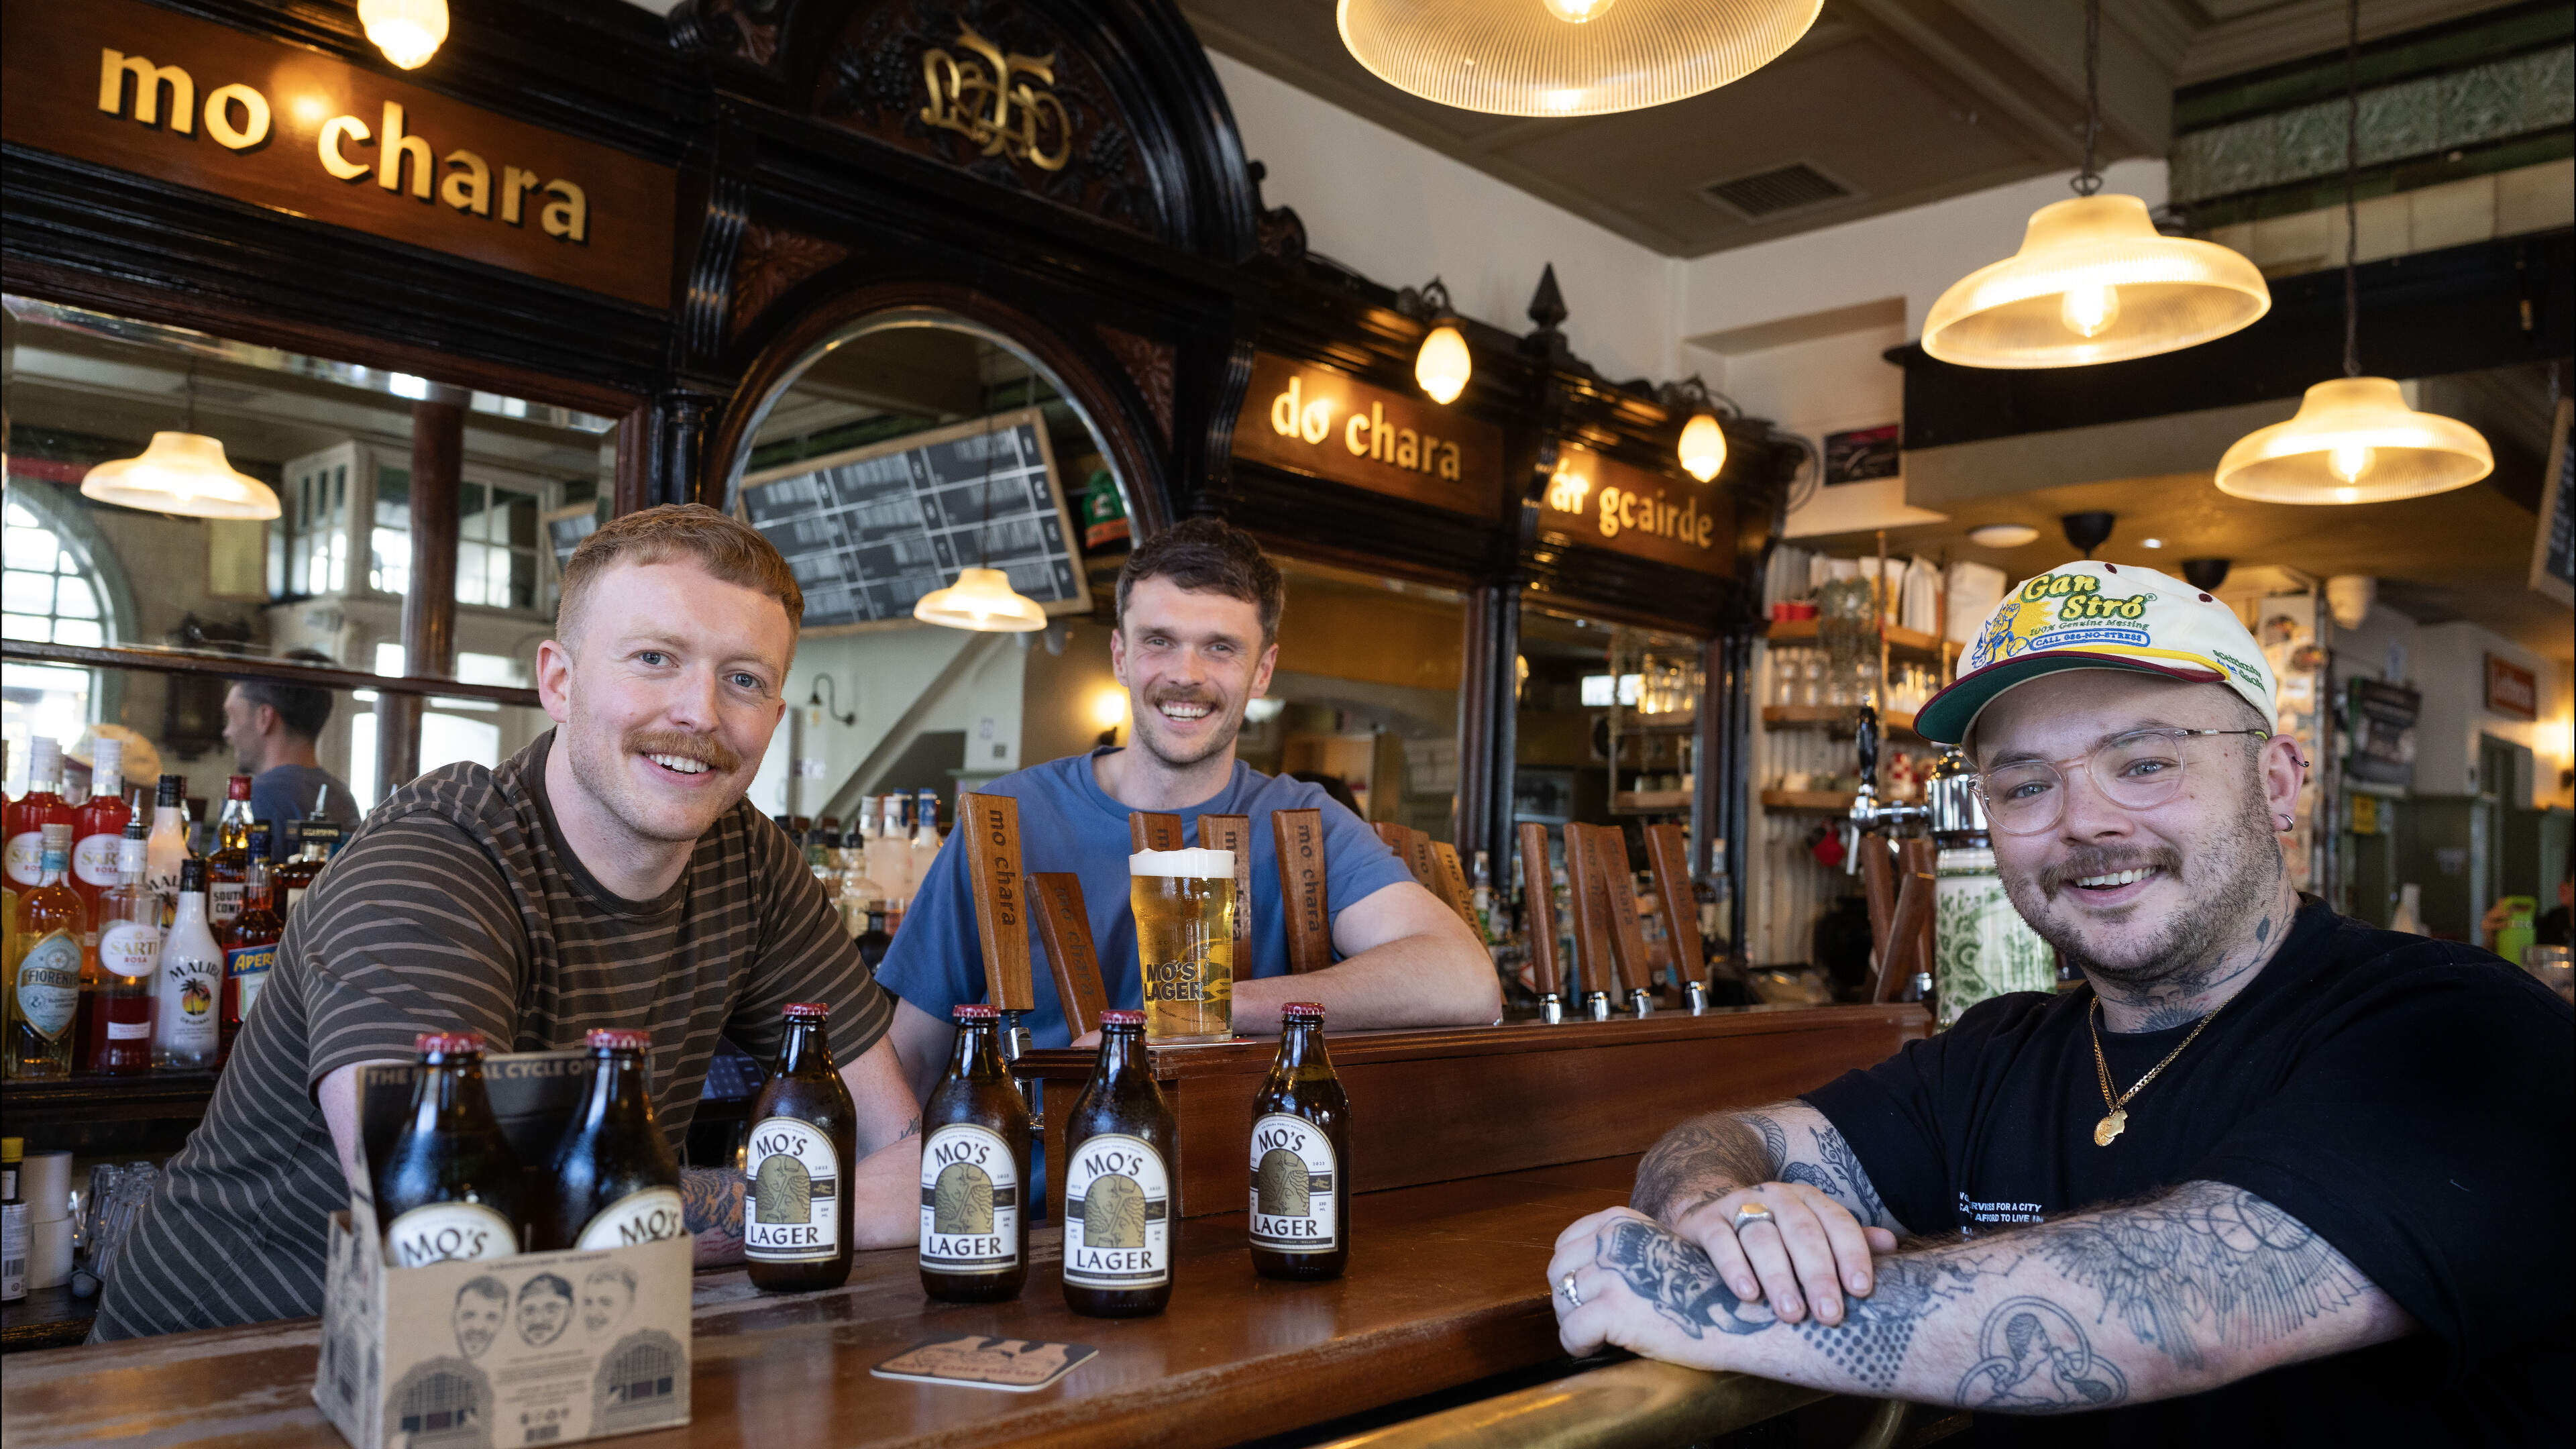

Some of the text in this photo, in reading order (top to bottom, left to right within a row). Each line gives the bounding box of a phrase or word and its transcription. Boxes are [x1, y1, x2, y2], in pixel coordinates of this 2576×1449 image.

[98, 46, 588, 242] mo chara
[1271, 376, 1463, 483] do chara
[1549, 458, 1714, 548] ár gcairde
[2021, 574, 2100, 602] Gan
[2058, 594, 2145, 621] Stró
[2029, 619, 2150, 637] 100% Genuine Messing
[2035, 635, 2061, 647] CALL
[1157, 828, 1169, 851] m
[989, 810, 1016, 926] mo chara
[1298, 825, 1320, 932] mo chara
[1055, 887, 1094, 996] mo chara
[1146, 961, 1196, 983] MO'S
[1144, 981, 1205, 1002] LAGER
[505, 1061, 564, 1079] CYCLE
[756, 1133, 808, 1160] MO'S
[1258, 1128, 1306, 1153] MO'S
[934, 1140, 991, 1168] MO'S
[1084, 1151, 1144, 1179] MO'S
[1996, 1202, 2011, 1211] FOR
[2012, 1202, 2018, 1211] A
[2019, 1203, 2042, 1212] CITY
[2000, 1214, 2011, 1222] TO
[2012, 1214, 2030, 1222] LIVE
[750, 1225, 819, 1245] LAGER
[1254, 1215, 1318, 1236] LAGER
[403, 1226, 488, 1269] MO'S
[928, 1236, 1002, 1256] LAGER
[1077, 1248, 1152, 1271] LAGER
